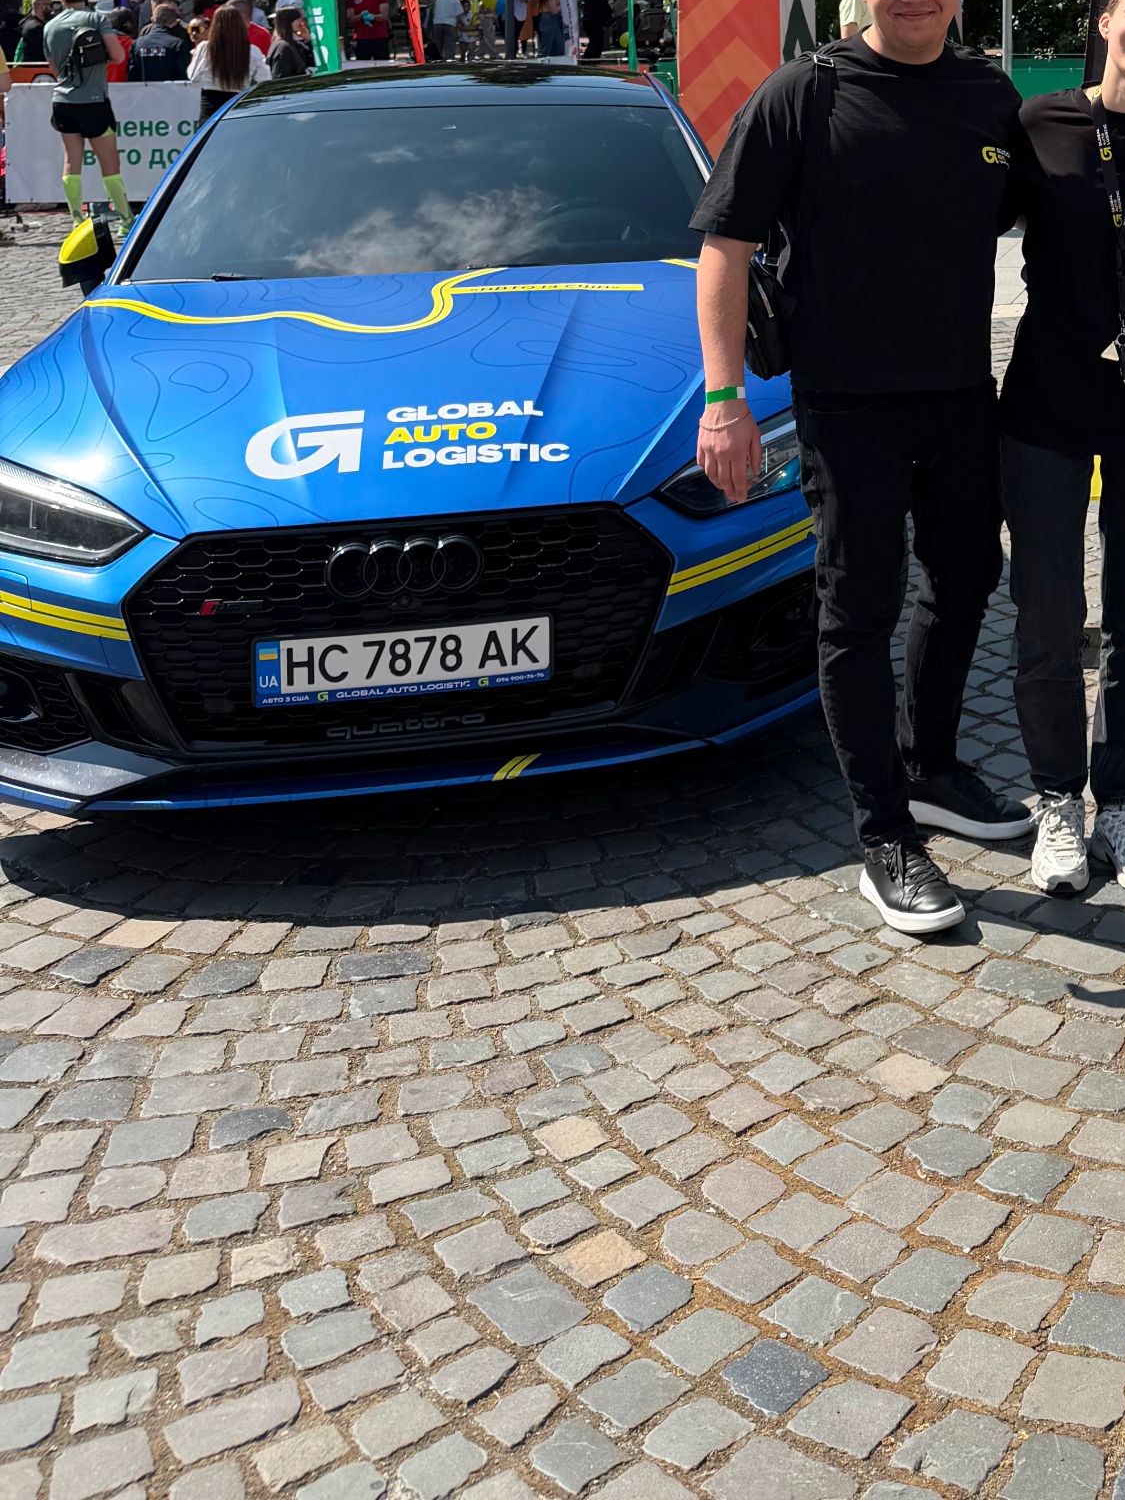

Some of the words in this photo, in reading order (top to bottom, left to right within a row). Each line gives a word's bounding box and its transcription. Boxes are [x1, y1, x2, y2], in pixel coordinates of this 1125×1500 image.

[386, 400, 544, 423] GLOBAL
[384, 421, 497, 445] AUTO
[382, 443, 570, 470] LOGISTIC
[285, 644, 349, 686] HC
[362, 634, 463, 680] 7878
[478, 625, 540, 670] AK
[258, 675, 279, 689] UA
[336, 688, 384, 699] GLOBAL
[386, 685, 418, 695] AUTO
[420, 680, 471, 692] LOGISTIC
[262, 696, 284, 704] АВТО
[326, 713, 486, 740] quattro
